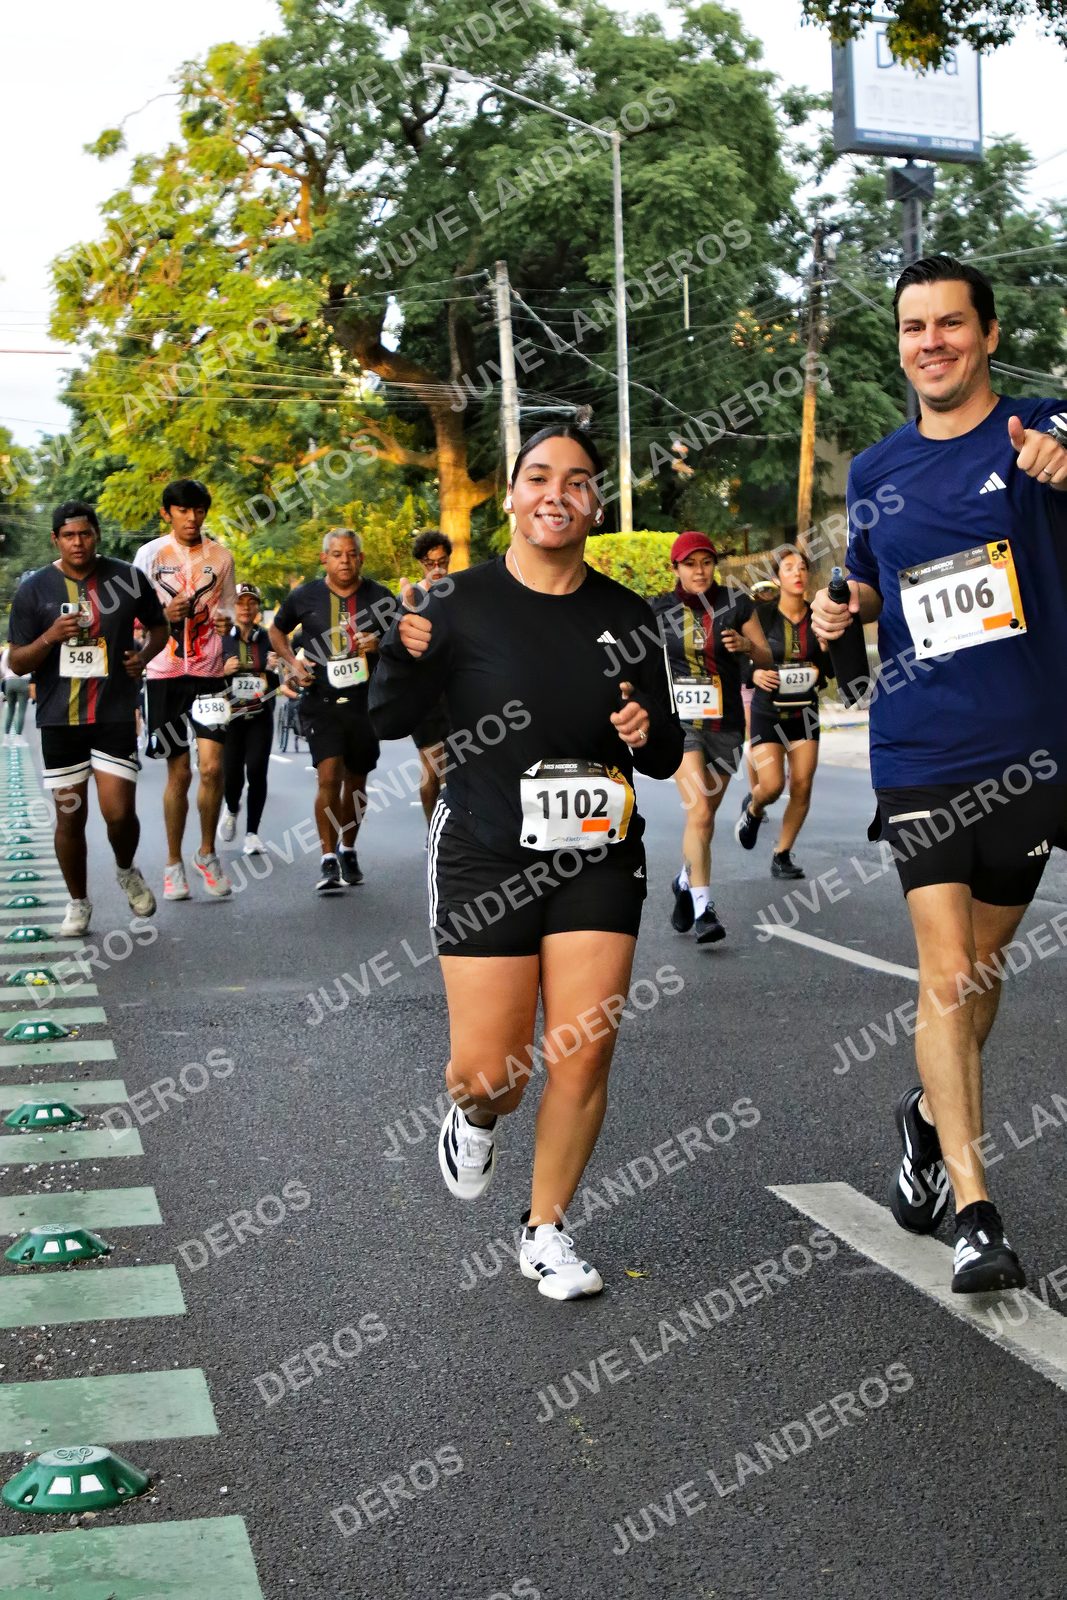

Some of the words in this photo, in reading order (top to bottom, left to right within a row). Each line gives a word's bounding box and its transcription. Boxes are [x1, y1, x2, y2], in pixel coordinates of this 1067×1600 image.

[918, 577, 995, 624] 1106
[69, 651, 93, 664] 548
[333, 662, 360, 676] 6015
[786, 672, 811, 685] 6231
[676, 691, 711, 704] 6512
[536, 788, 608, 820] 1102
